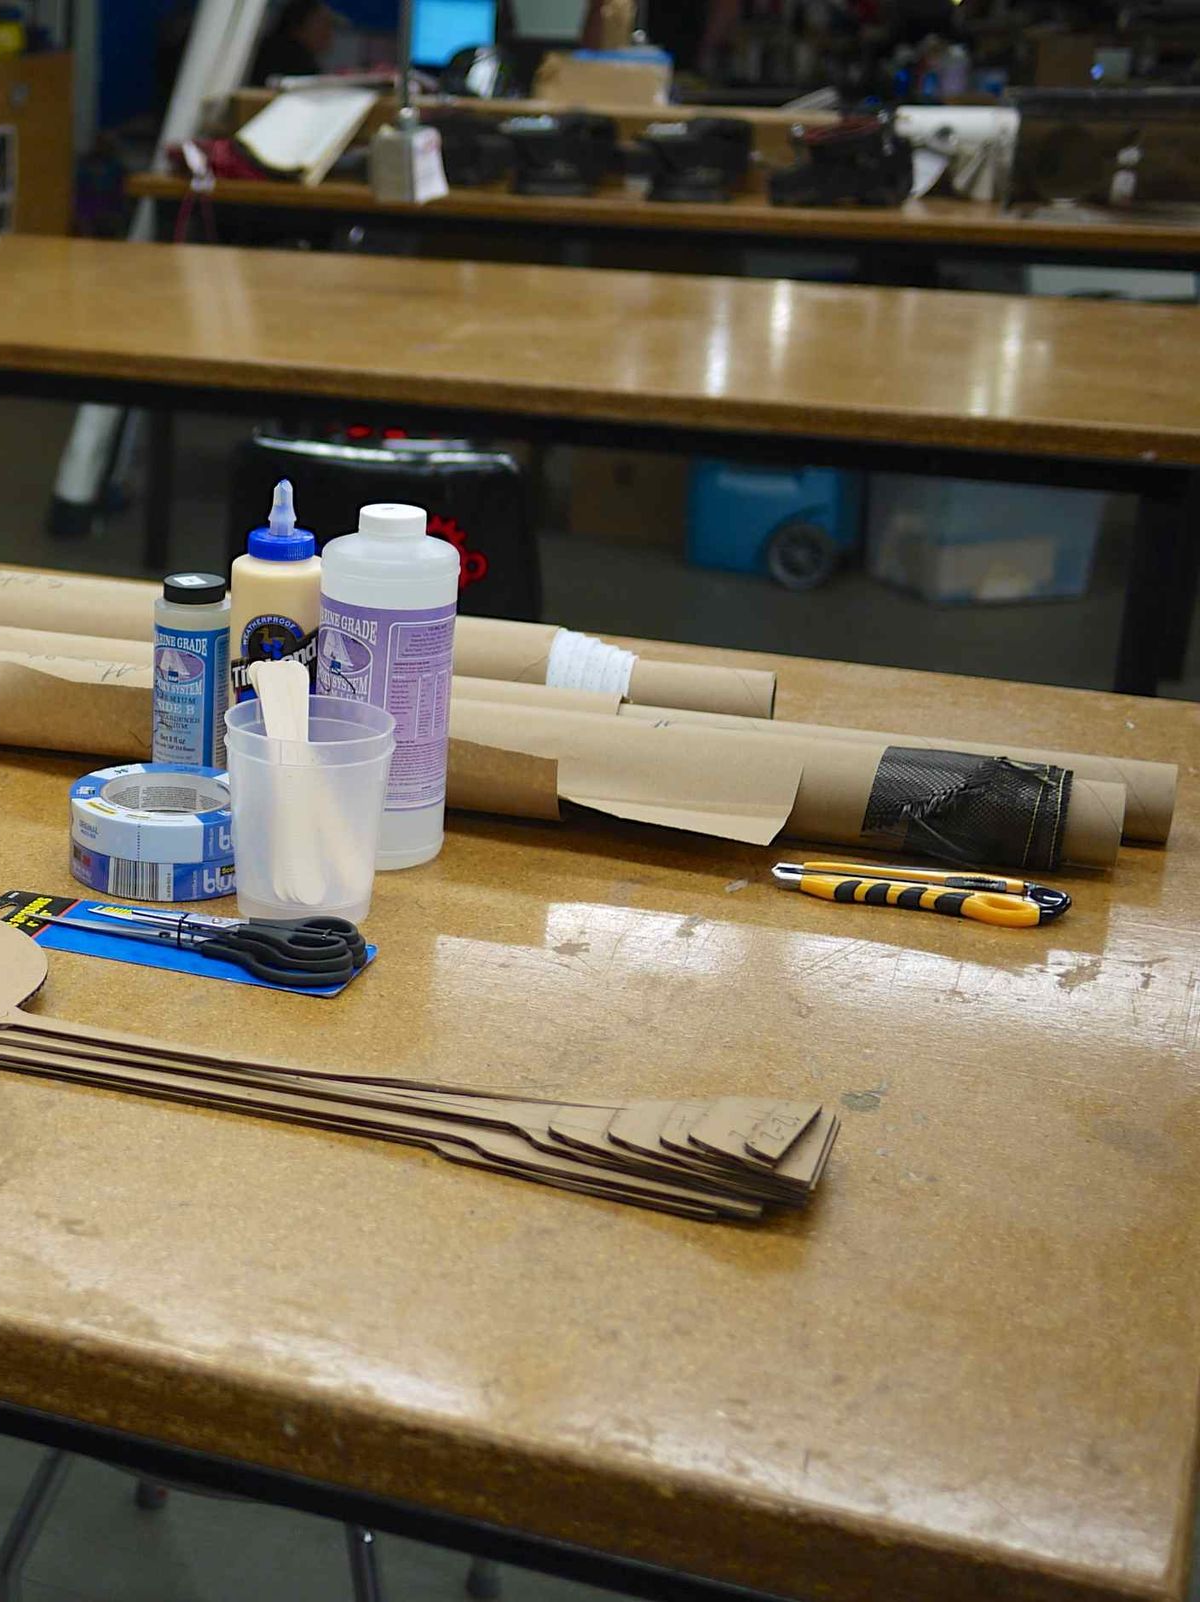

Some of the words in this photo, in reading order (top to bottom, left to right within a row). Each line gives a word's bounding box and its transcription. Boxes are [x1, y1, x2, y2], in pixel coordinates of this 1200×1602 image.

[242, 616, 296, 645] WEATHERPROOF
[341, 615, 378, 646] GRADE
[177, 636, 208, 657] GRADE
[203, 864, 238, 895] blu
